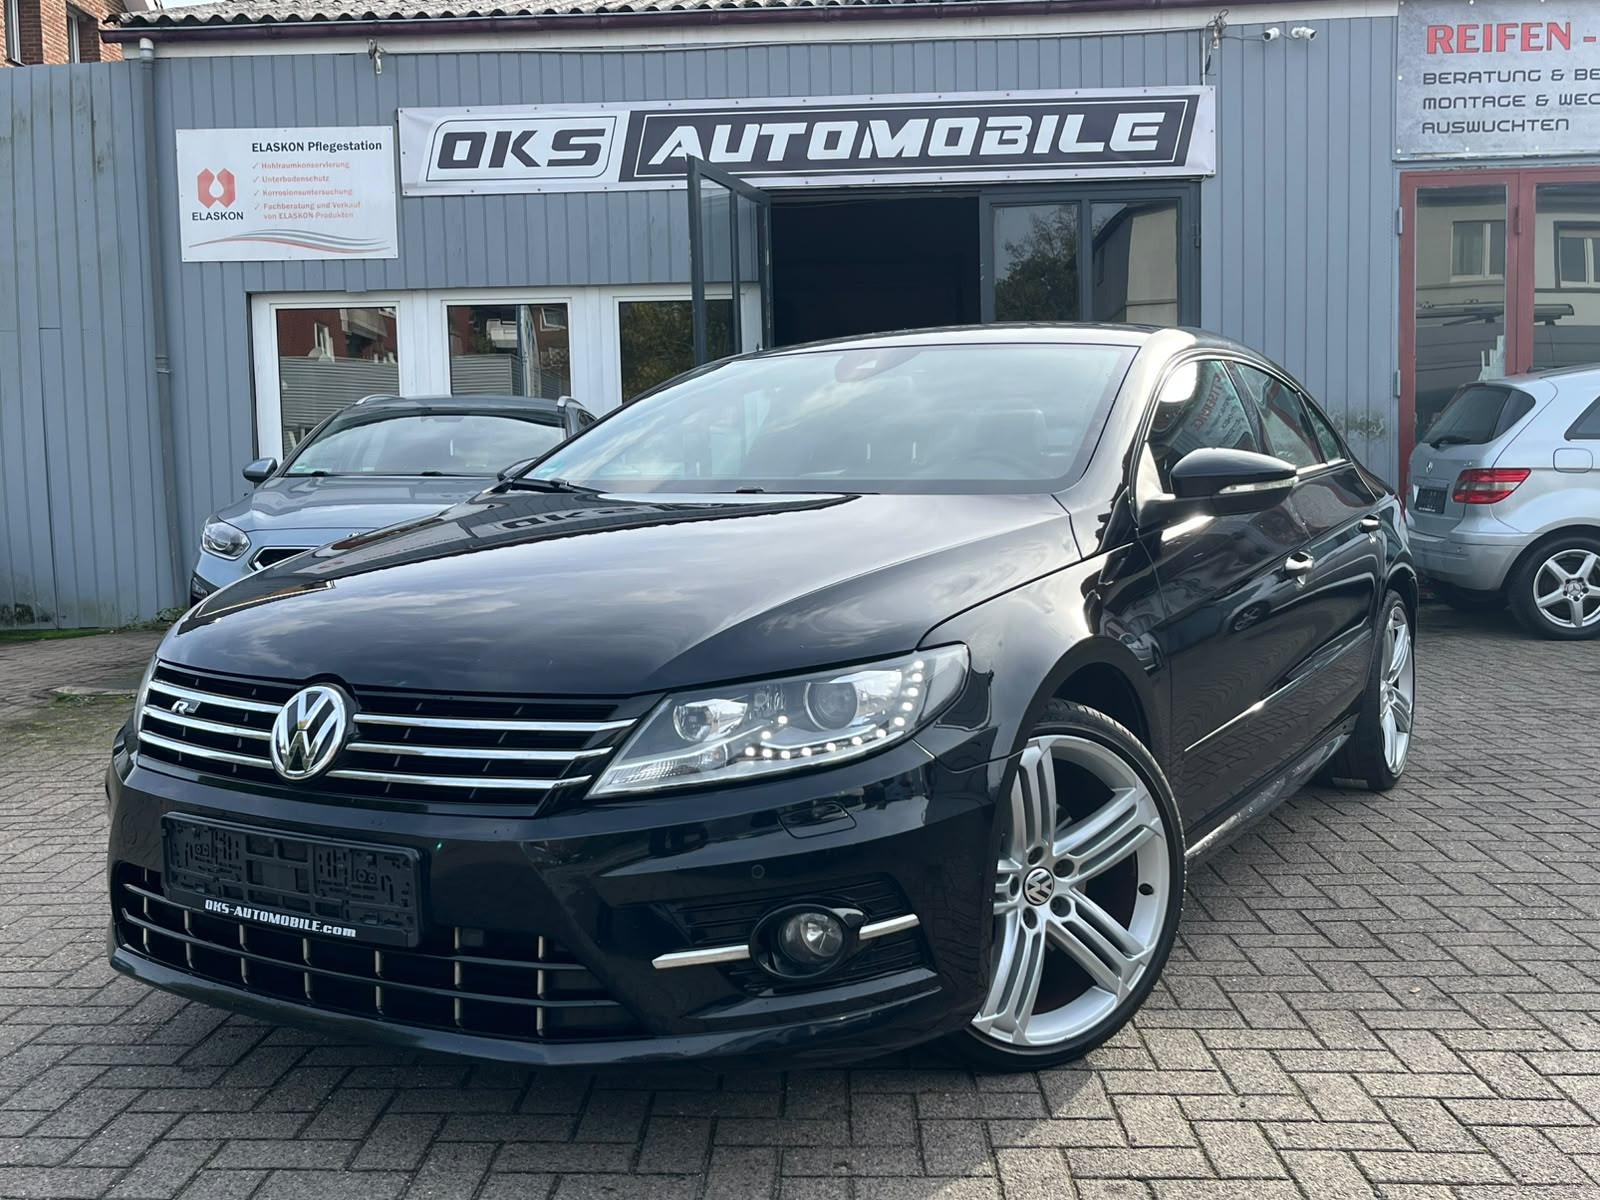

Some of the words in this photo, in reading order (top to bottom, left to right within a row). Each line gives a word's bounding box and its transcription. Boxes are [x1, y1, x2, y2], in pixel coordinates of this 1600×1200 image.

[1426, 22, 1571, 54] REIFEN
[1423, 70, 1541, 85] BERATUNG
[1550, 69, 1565, 81] &
[1423, 95, 1526, 110] MONTAGE
[1535, 94, 1549, 107] &
[1422, 118, 1569, 134] AUSWUCHTEN
[437, 128, 606, 169] OKS
[648, 112, 1166, 165] AUTOMOBILE
[252, 142, 304, 153] ELASKON
[307, 141, 382, 154] Pflegestation
[261, 160, 350, 169] Hohlraumkonservierung
[262, 175, 330, 183] Unterbodenschutz
[262, 188, 353, 196] Korrosionsuntersuchung
[263, 202, 315, 210] Fachberatung
[191, 211, 244, 221] ELASKON
[279, 211, 314, 219] ELASKON
[315, 210, 354, 219] Produkten
[205, 899, 357, 938] OKS-AUTOMOBILE.com
